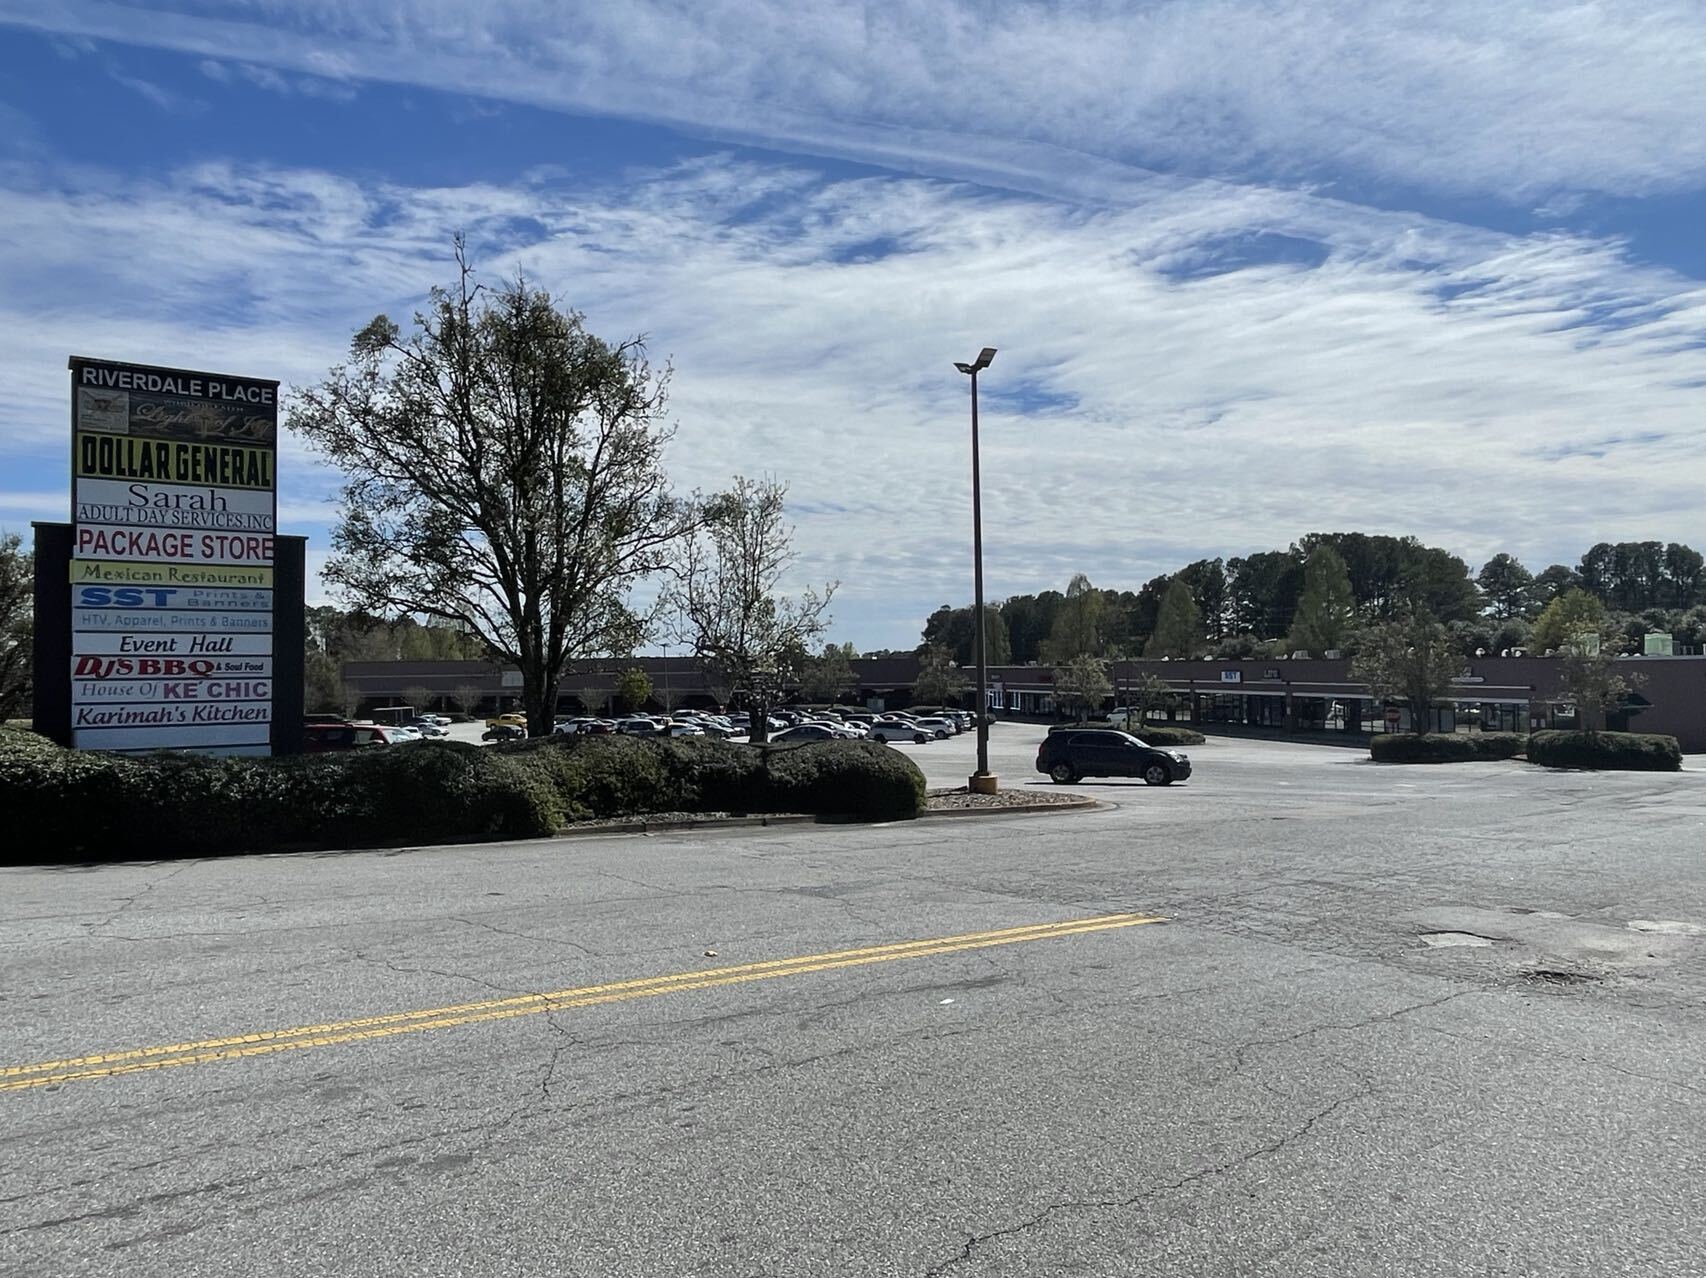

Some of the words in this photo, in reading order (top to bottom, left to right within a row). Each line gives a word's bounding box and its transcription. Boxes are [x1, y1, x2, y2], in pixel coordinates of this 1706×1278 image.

[83, 367, 203, 397] RIVERDALE
[208, 381, 273, 404] PLACE
[81, 435, 170, 481] DOLLAR
[175, 444, 271, 488] GENERAL
[128, 484, 228, 512] Sarah
[79, 504, 134, 522] ADULT
[137, 508, 168, 524] DAY
[79, 529, 194, 558] PACKAGE
[201, 535, 275, 561] STORE
[81, 564, 163, 581] Mexican
[168, 568, 265, 585] Restaurant
[80, 587, 177, 607] SST
[255, 591, 265, 600] &
[187, 599, 270, 608] Banners
[81, 614, 111, 627] HTV,
[115, 614, 167, 628] Apparel,
[171, 616, 206, 627] Prints
[210, 616, 217, 627] &
[221, 616, 269, 628] Banners
[119, 635, 178, 653] Event
[189, 634, 234, 654] Hall
[138, 659, 215, 679] BBQ
[224, 663, 242, 671] Soul
[244, 663, 264, 671] Food
[81, 683, 138, 697] House
[139, 682, 159, 699] Of
[207, 681, 268, 699] CHIC
[76, 706, 186, 725] Karimah's
[192, 704, 268, 722] Kitchen
